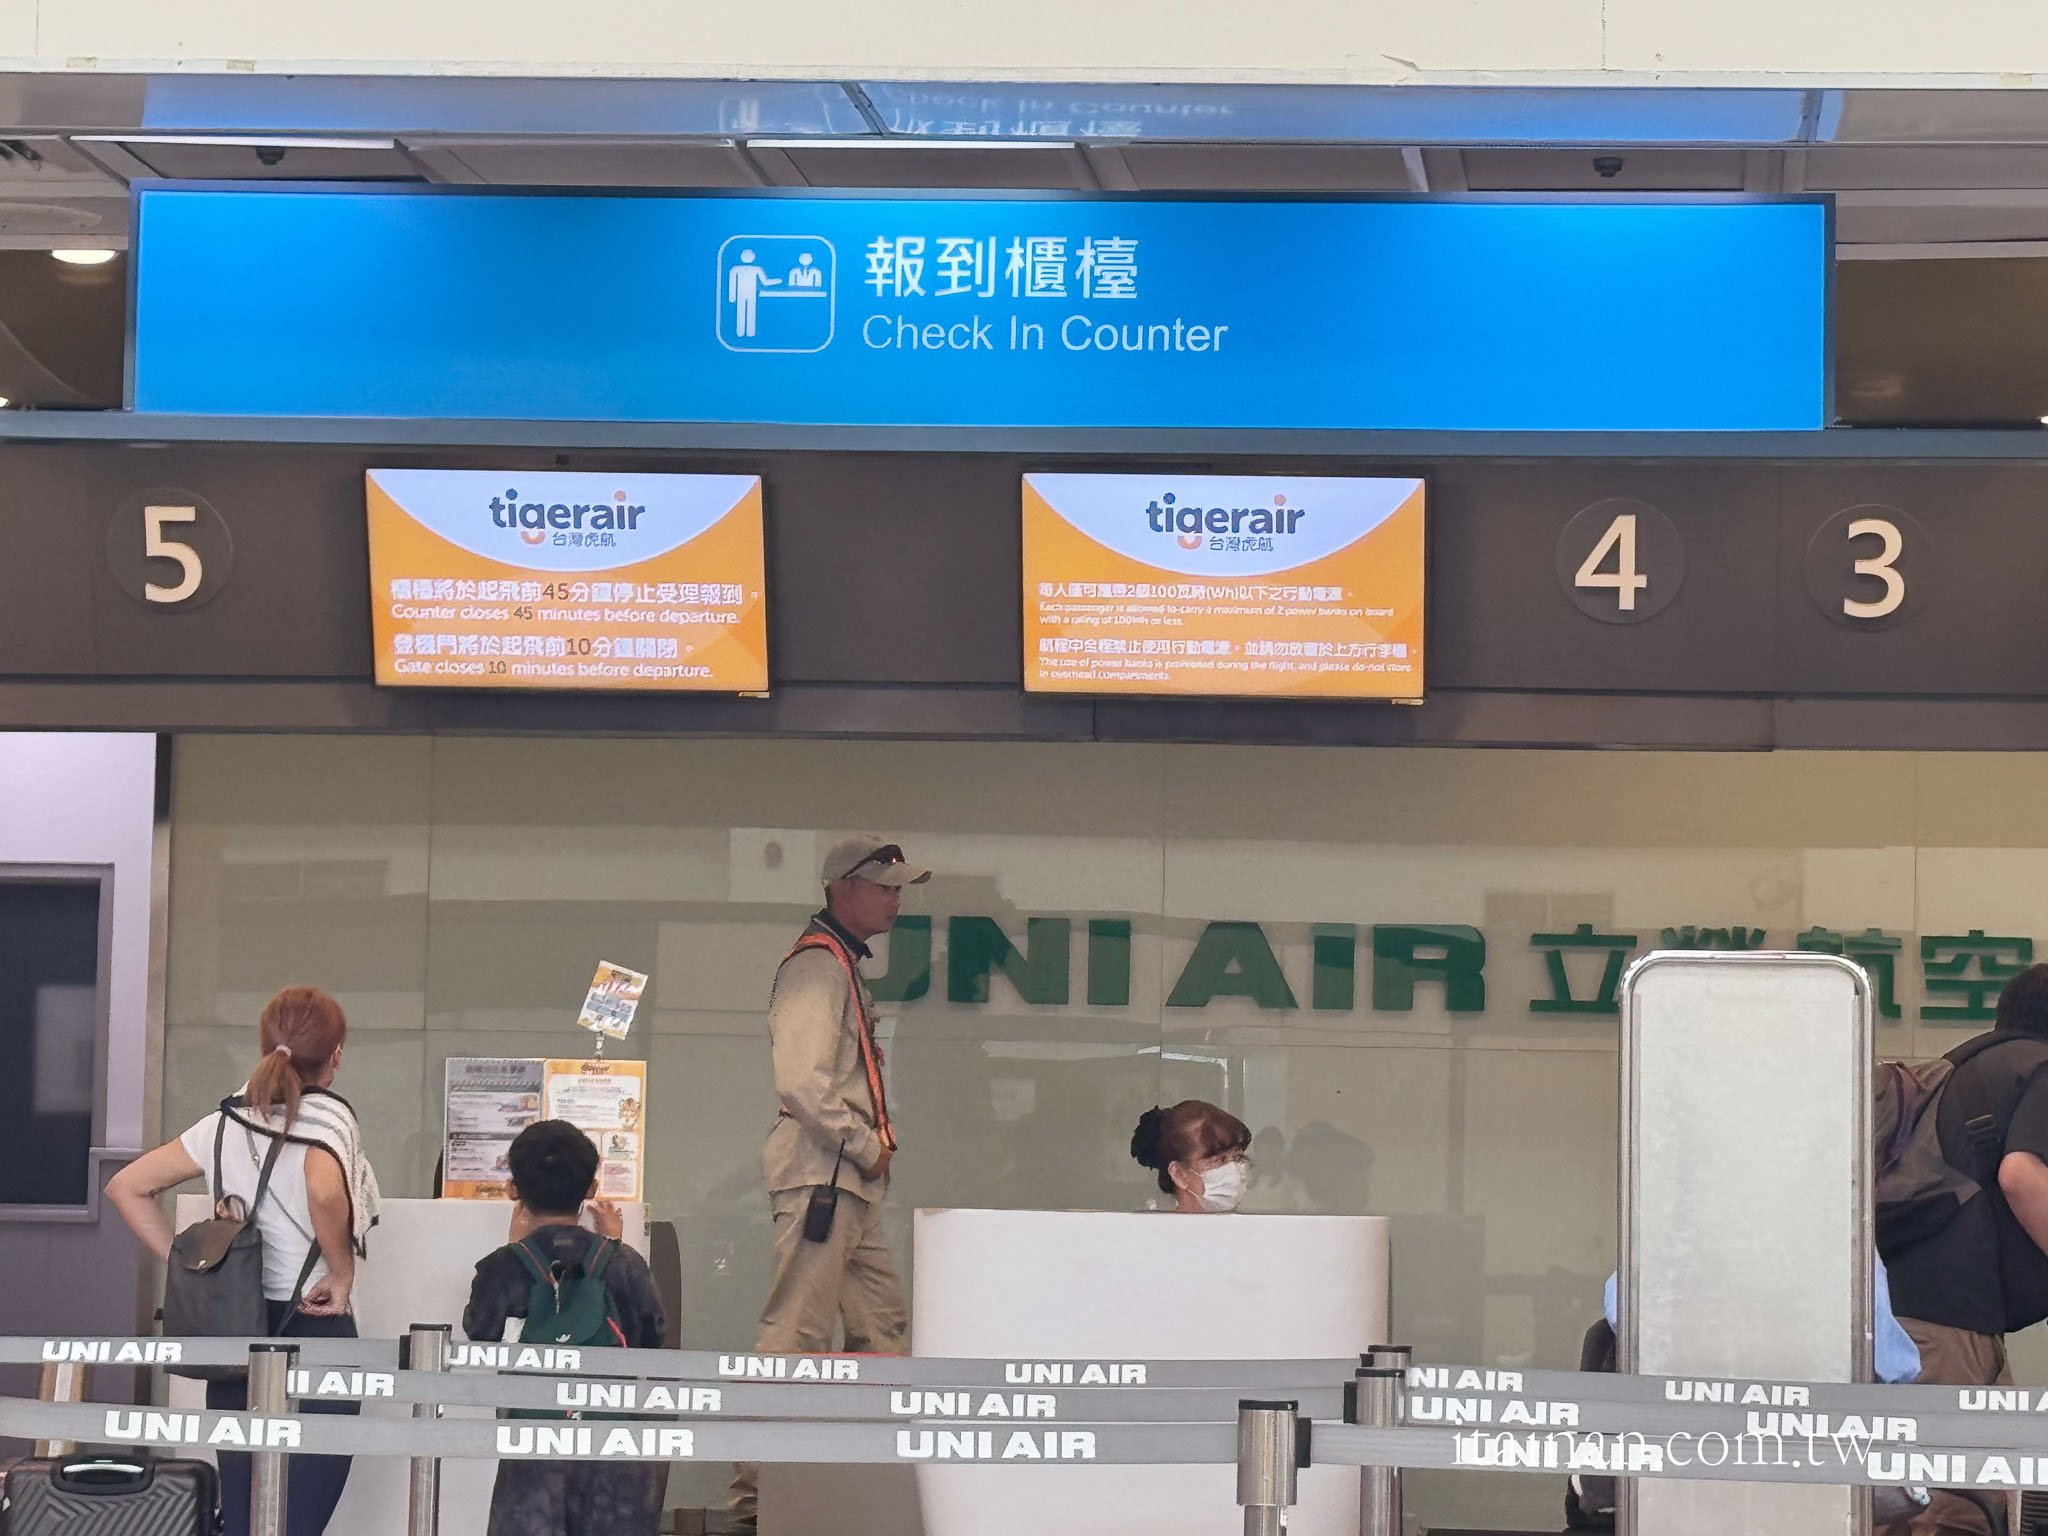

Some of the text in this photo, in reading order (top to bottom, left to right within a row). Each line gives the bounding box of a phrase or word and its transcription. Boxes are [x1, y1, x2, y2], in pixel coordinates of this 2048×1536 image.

[863, 234, 1140, 299] 報到櫃檯
[862, 314, 1229, 352] Check In Counter
[489, 488, 646, 544] tigerair
[1146, 492, 1305, 549] tigerair
[145, 506, 203, 603] 5
[1575, 514, 1647, 610] 4
[1844, 518, 1905, 618] 3
[392, 603, 456, 619] Counter
[460, 604, 510, 620] closes
[513, 606, 533, 620] 45
[537, 607, 600, 622] minutes
[604, 608, 656, 623] before
[394, 657, 432, 674] Gate
[435, 659, 485, 675] closes
[489, 660, 506, 674] 10
[511, 660, 574, 676] minutes
[577, 661, 629, 677] before
[1166, 920, 1488, 1012] AIR
[42, 1341, 183, 1363] UNI AIR
[514, 1347, 582, 1370] AIR
[719, 1355, 860, 1380] UNI AIR
[1005, 1363, 1147, 1385] UNI AIR
[1407, 1367, 1523, 1392] NI AIR
[316, 1370, 395, 1397] AIR
[556, 1382, 722, 1411] UNI AIR
[1665, 1380, 1810, 1407] UNI AIR
[890, 1391, 1057, 1418] UNI AIR
[1411, 1396, 1579, 1426] UNI AIR
[1959, 1389, 2029, 1411] UNI
[104, 1410, 302, 1447] UNI AIR
[496, 1426, 694, 1456] UNI AIR
[1747, 1411, 1918, 1441] UNI AIR
[896, 1430, 1096, 1459] UNI AIR
[1461, 1436, 1664, 1472] UNI AIR
[1867, 1451, 1966, 1483] UNI
